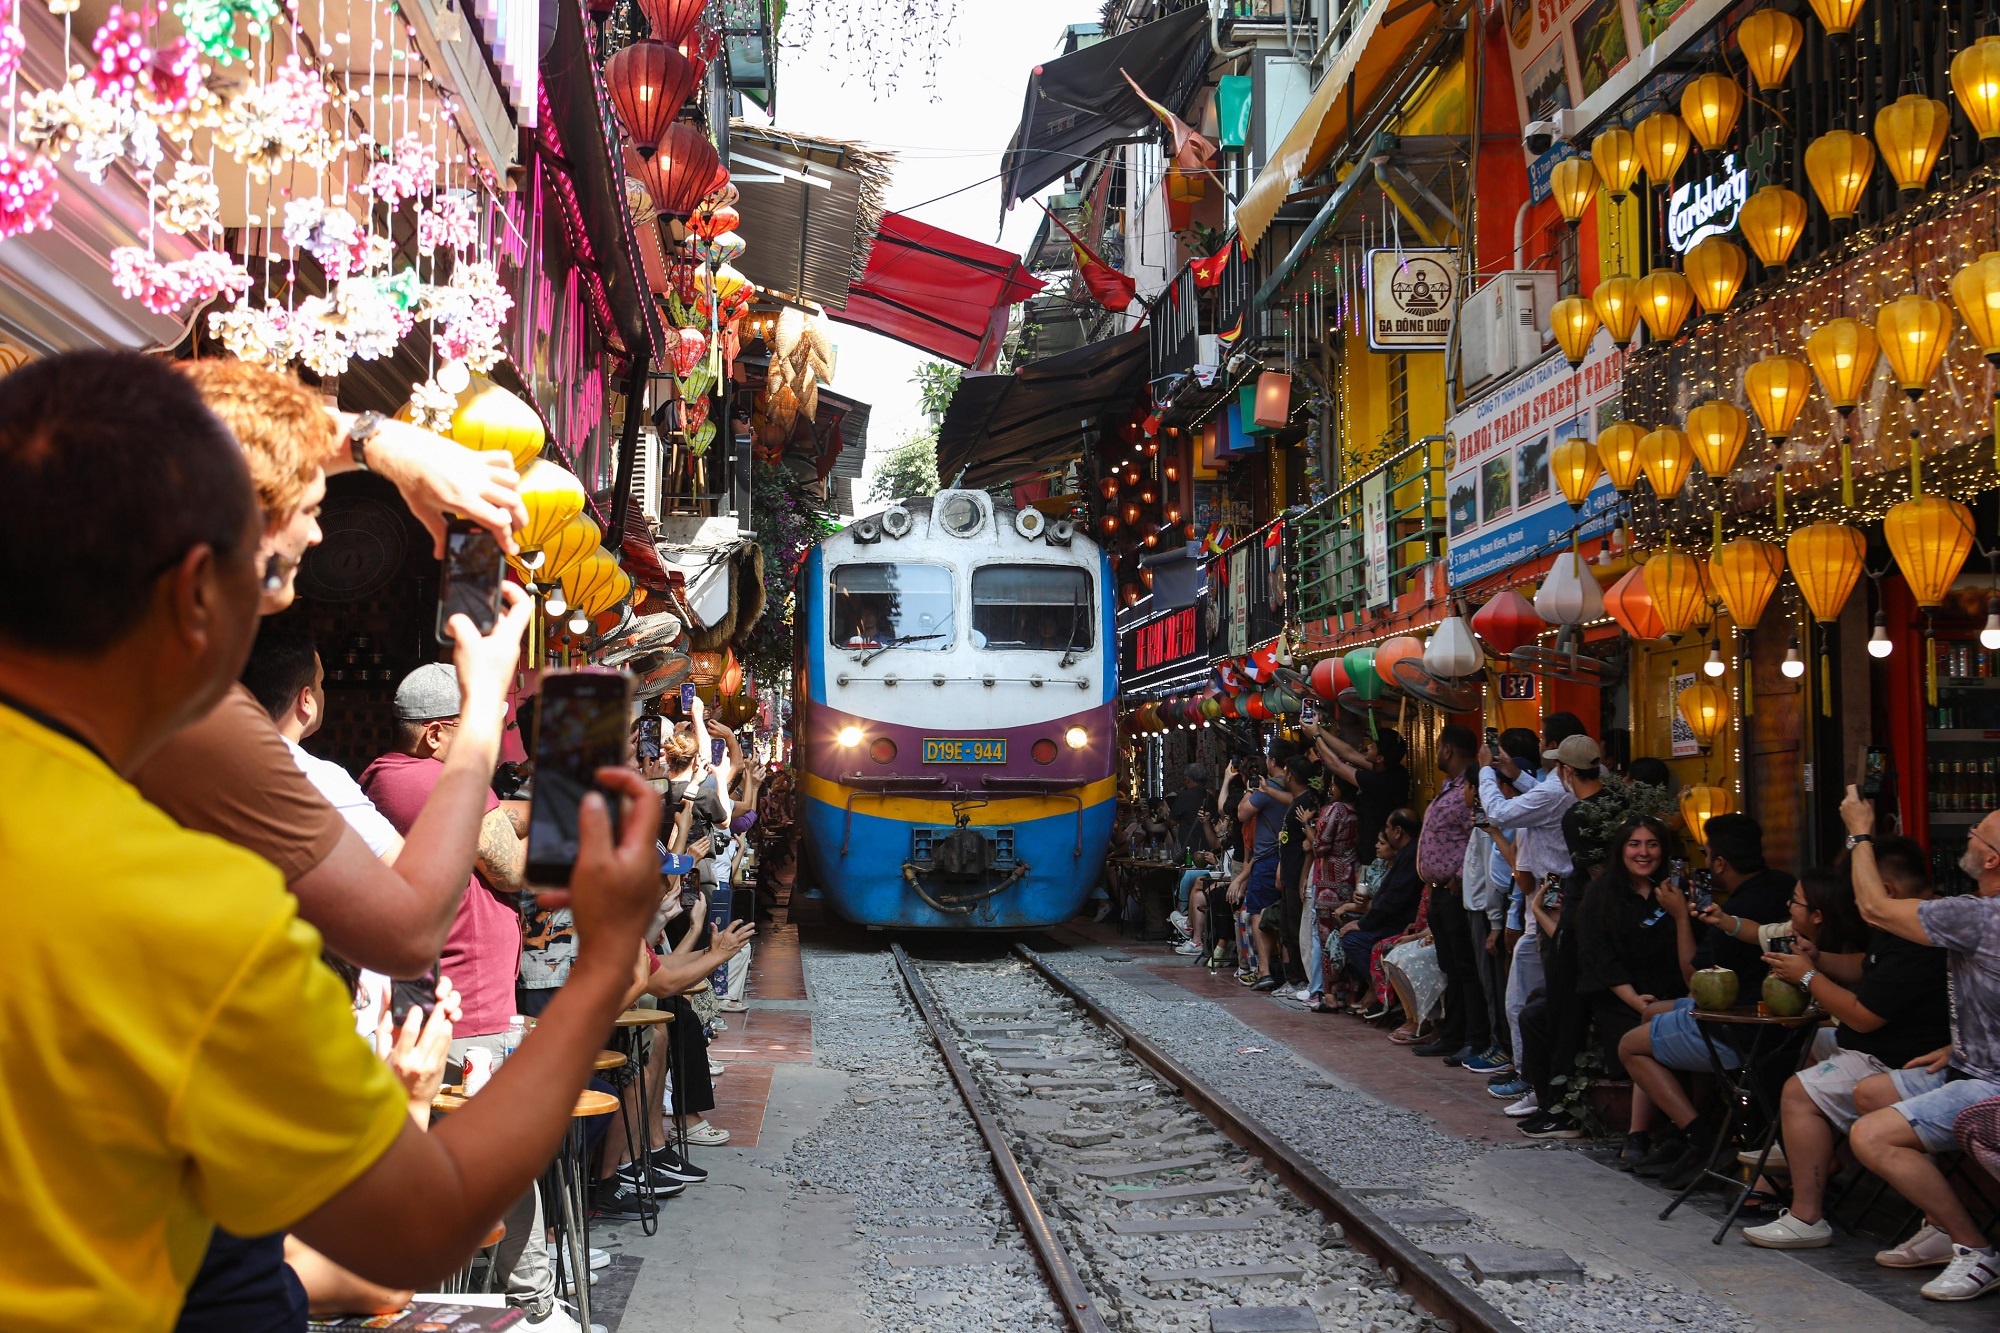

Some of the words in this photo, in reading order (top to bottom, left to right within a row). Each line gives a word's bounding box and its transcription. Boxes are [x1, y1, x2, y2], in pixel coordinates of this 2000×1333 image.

[1540, 160, 1551, 176] Tran
[1668, 160, 1748, 256] Carlsberg
[1379, 319, 1393, 332] GA
[1395, 317, 1424, 332] ĐÔNG
[1494, 394, 1501, 409] TY
[1501, 385, 1517, 405] TNHH
[1516, 373, 1536, 397] HANOI
[1536, 363, 1553, 386] TRAIN
[1533, 372, 1582, 425] STREET
[1454, 554, 1459, 567] 5
[1458, 552, 1470, 565] Tran
[1469, 547, 1480, 560] Phu,
[1480, 542, 1493, 556] Hoan
[1493, 537, 1508, 551] Kiem,
[1507, 527, 1524, 545] Hanoi
[1507, 677, 1529, 697] 37
[927, 741, 963, 760] D19E
[973, 742, 1003, 760] 944
